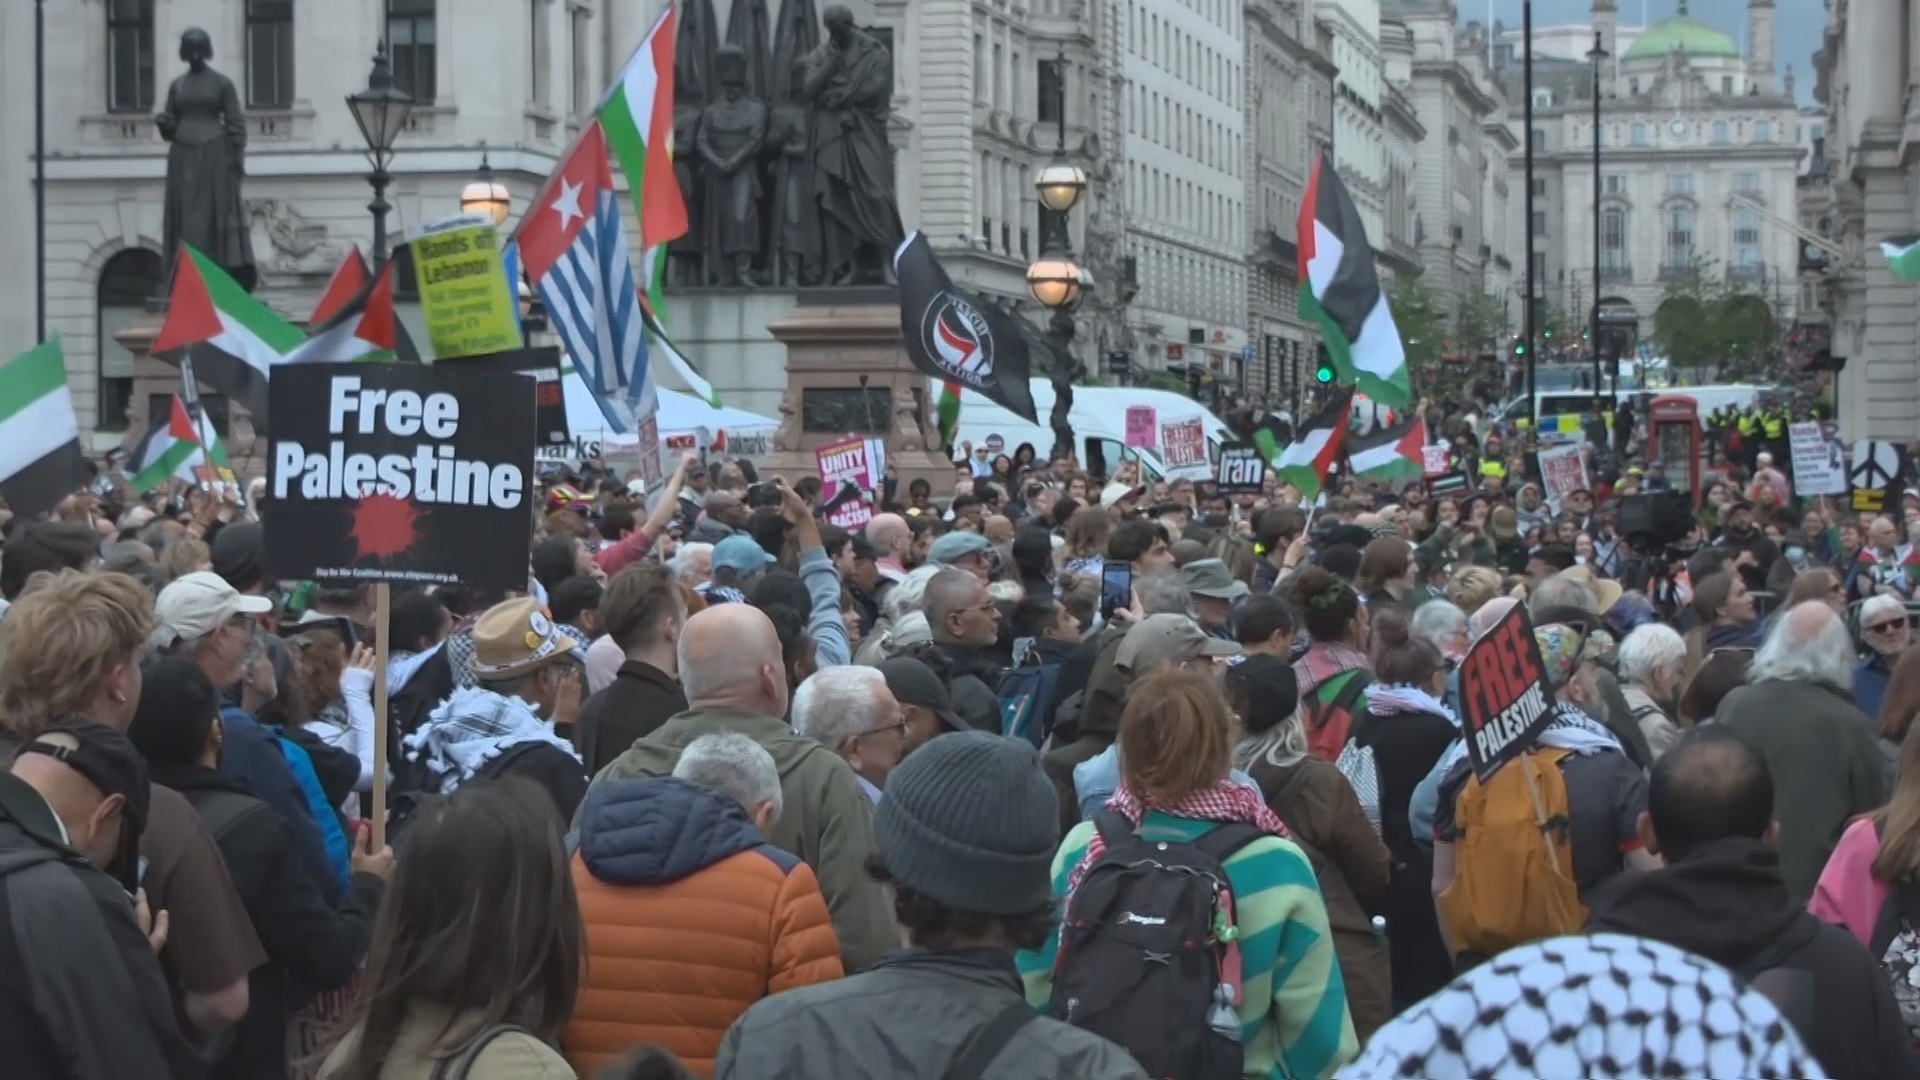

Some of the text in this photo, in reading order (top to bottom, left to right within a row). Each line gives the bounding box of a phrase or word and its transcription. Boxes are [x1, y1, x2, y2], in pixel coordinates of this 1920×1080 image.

[329, 375, 460, 438] Free
[274, 440, 523, 509] Palestine
[820, 447, 864, 476] UNITY
[1219, 453, 1260, 484] Iran
[830, 507, 872, 528] RACISM
[1463, 611, 1539, 730] FREE
[1475, 679, 1548, 764] PALESTINE
